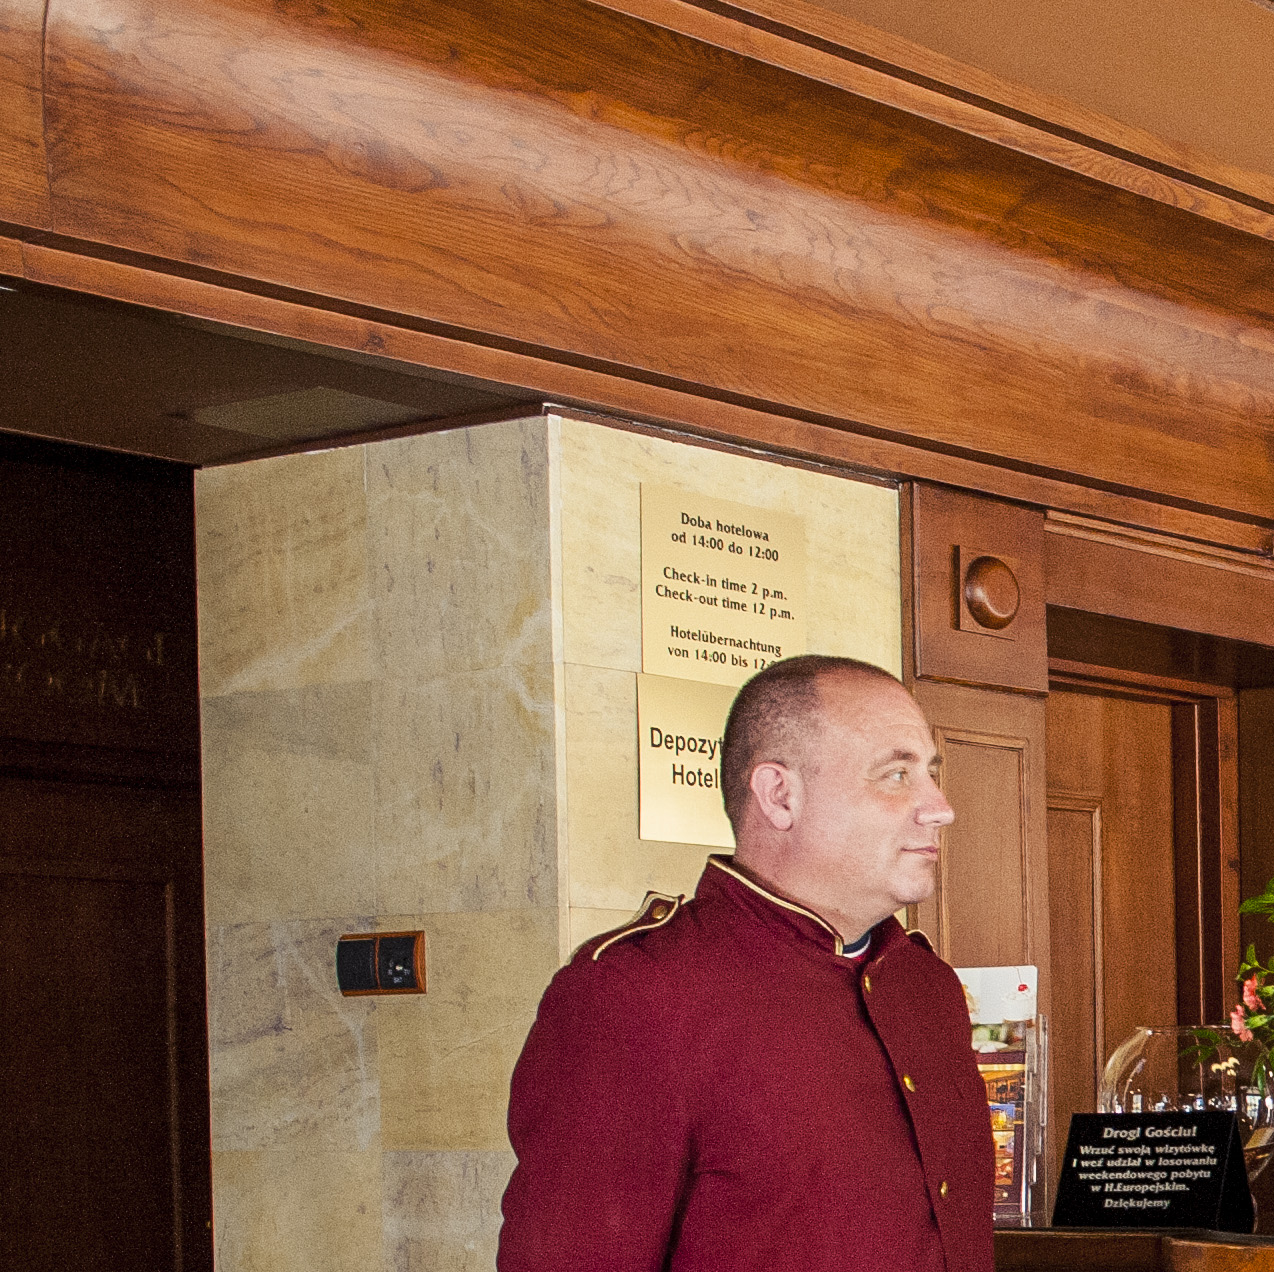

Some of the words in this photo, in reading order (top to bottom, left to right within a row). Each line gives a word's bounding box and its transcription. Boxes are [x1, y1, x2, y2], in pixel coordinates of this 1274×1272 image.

[680, 511, 713, 531] Doba
[716, 519, 770, 542] hotelowa
[671, 531, 687, 544] od
[692, 534, 725, 551] 14:00
[728, 541, 743, 556] do
[749, 545, 780, 562] 12:00
[663, 566, 717, 588] Check-in
[721, 577, 747, 593] time
[751, 582, 758, 595] 2
[762, 586, 788, 601] p.m.
[655, 584, 719, 607] Check-out
[721, 596, 748, 612] time
[753, 602, 766, 615] 12
[769, 607, 795, 621] p.m.
[670, 624, 782, 658] Hotelübernachtung
[667, 646, 690, 659] von
[694, 648, 727, 664] 14:00
[731, 653, 749, 668] bis
[1103, 1126, 1141, 1141] Drogi
[1145, 1125, 1198, 1138] Gościu!
[1079, 1145, 1116, 1155] Wrzuć
[1118, 1144, 1151, 1156] swoją
[1155, 1143, 1215, 1156] wizytówkę
[1106, 1157, 1142, 1167] udział
[1158, 1156, 1217, 1166] losowaniu
[1079, 1169, 1168, 1181] weekendowego
[1170, 1168, 1212, 1181] pobytu
[1091, 1184, 1102, 1192] w
[1104, 1197, 1171, 1211] Dziękujemy
